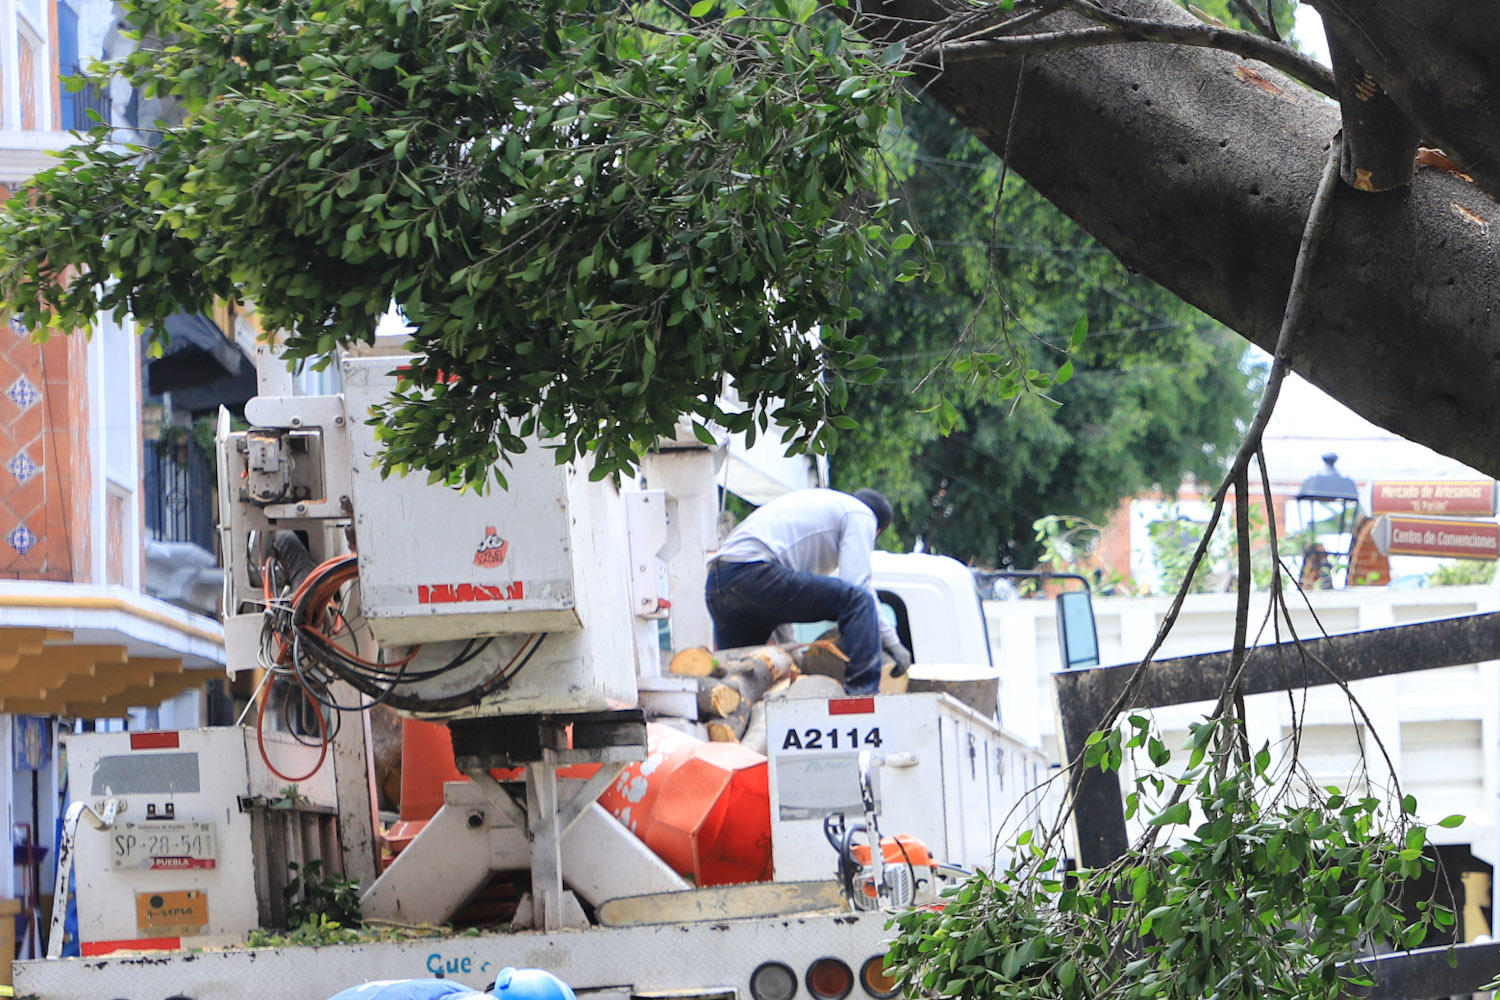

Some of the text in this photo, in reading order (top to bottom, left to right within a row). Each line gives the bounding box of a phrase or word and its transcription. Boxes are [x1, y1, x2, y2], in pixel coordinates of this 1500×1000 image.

[1381, 485, 1420, 498] Mercado
[1421, 485, 1434, 498] de
[1392, 529, 1497, 549] Centro de Convenciones
[782, 727, 883, 750] A2114
[156, 858, 190, 867] PUEBLA
